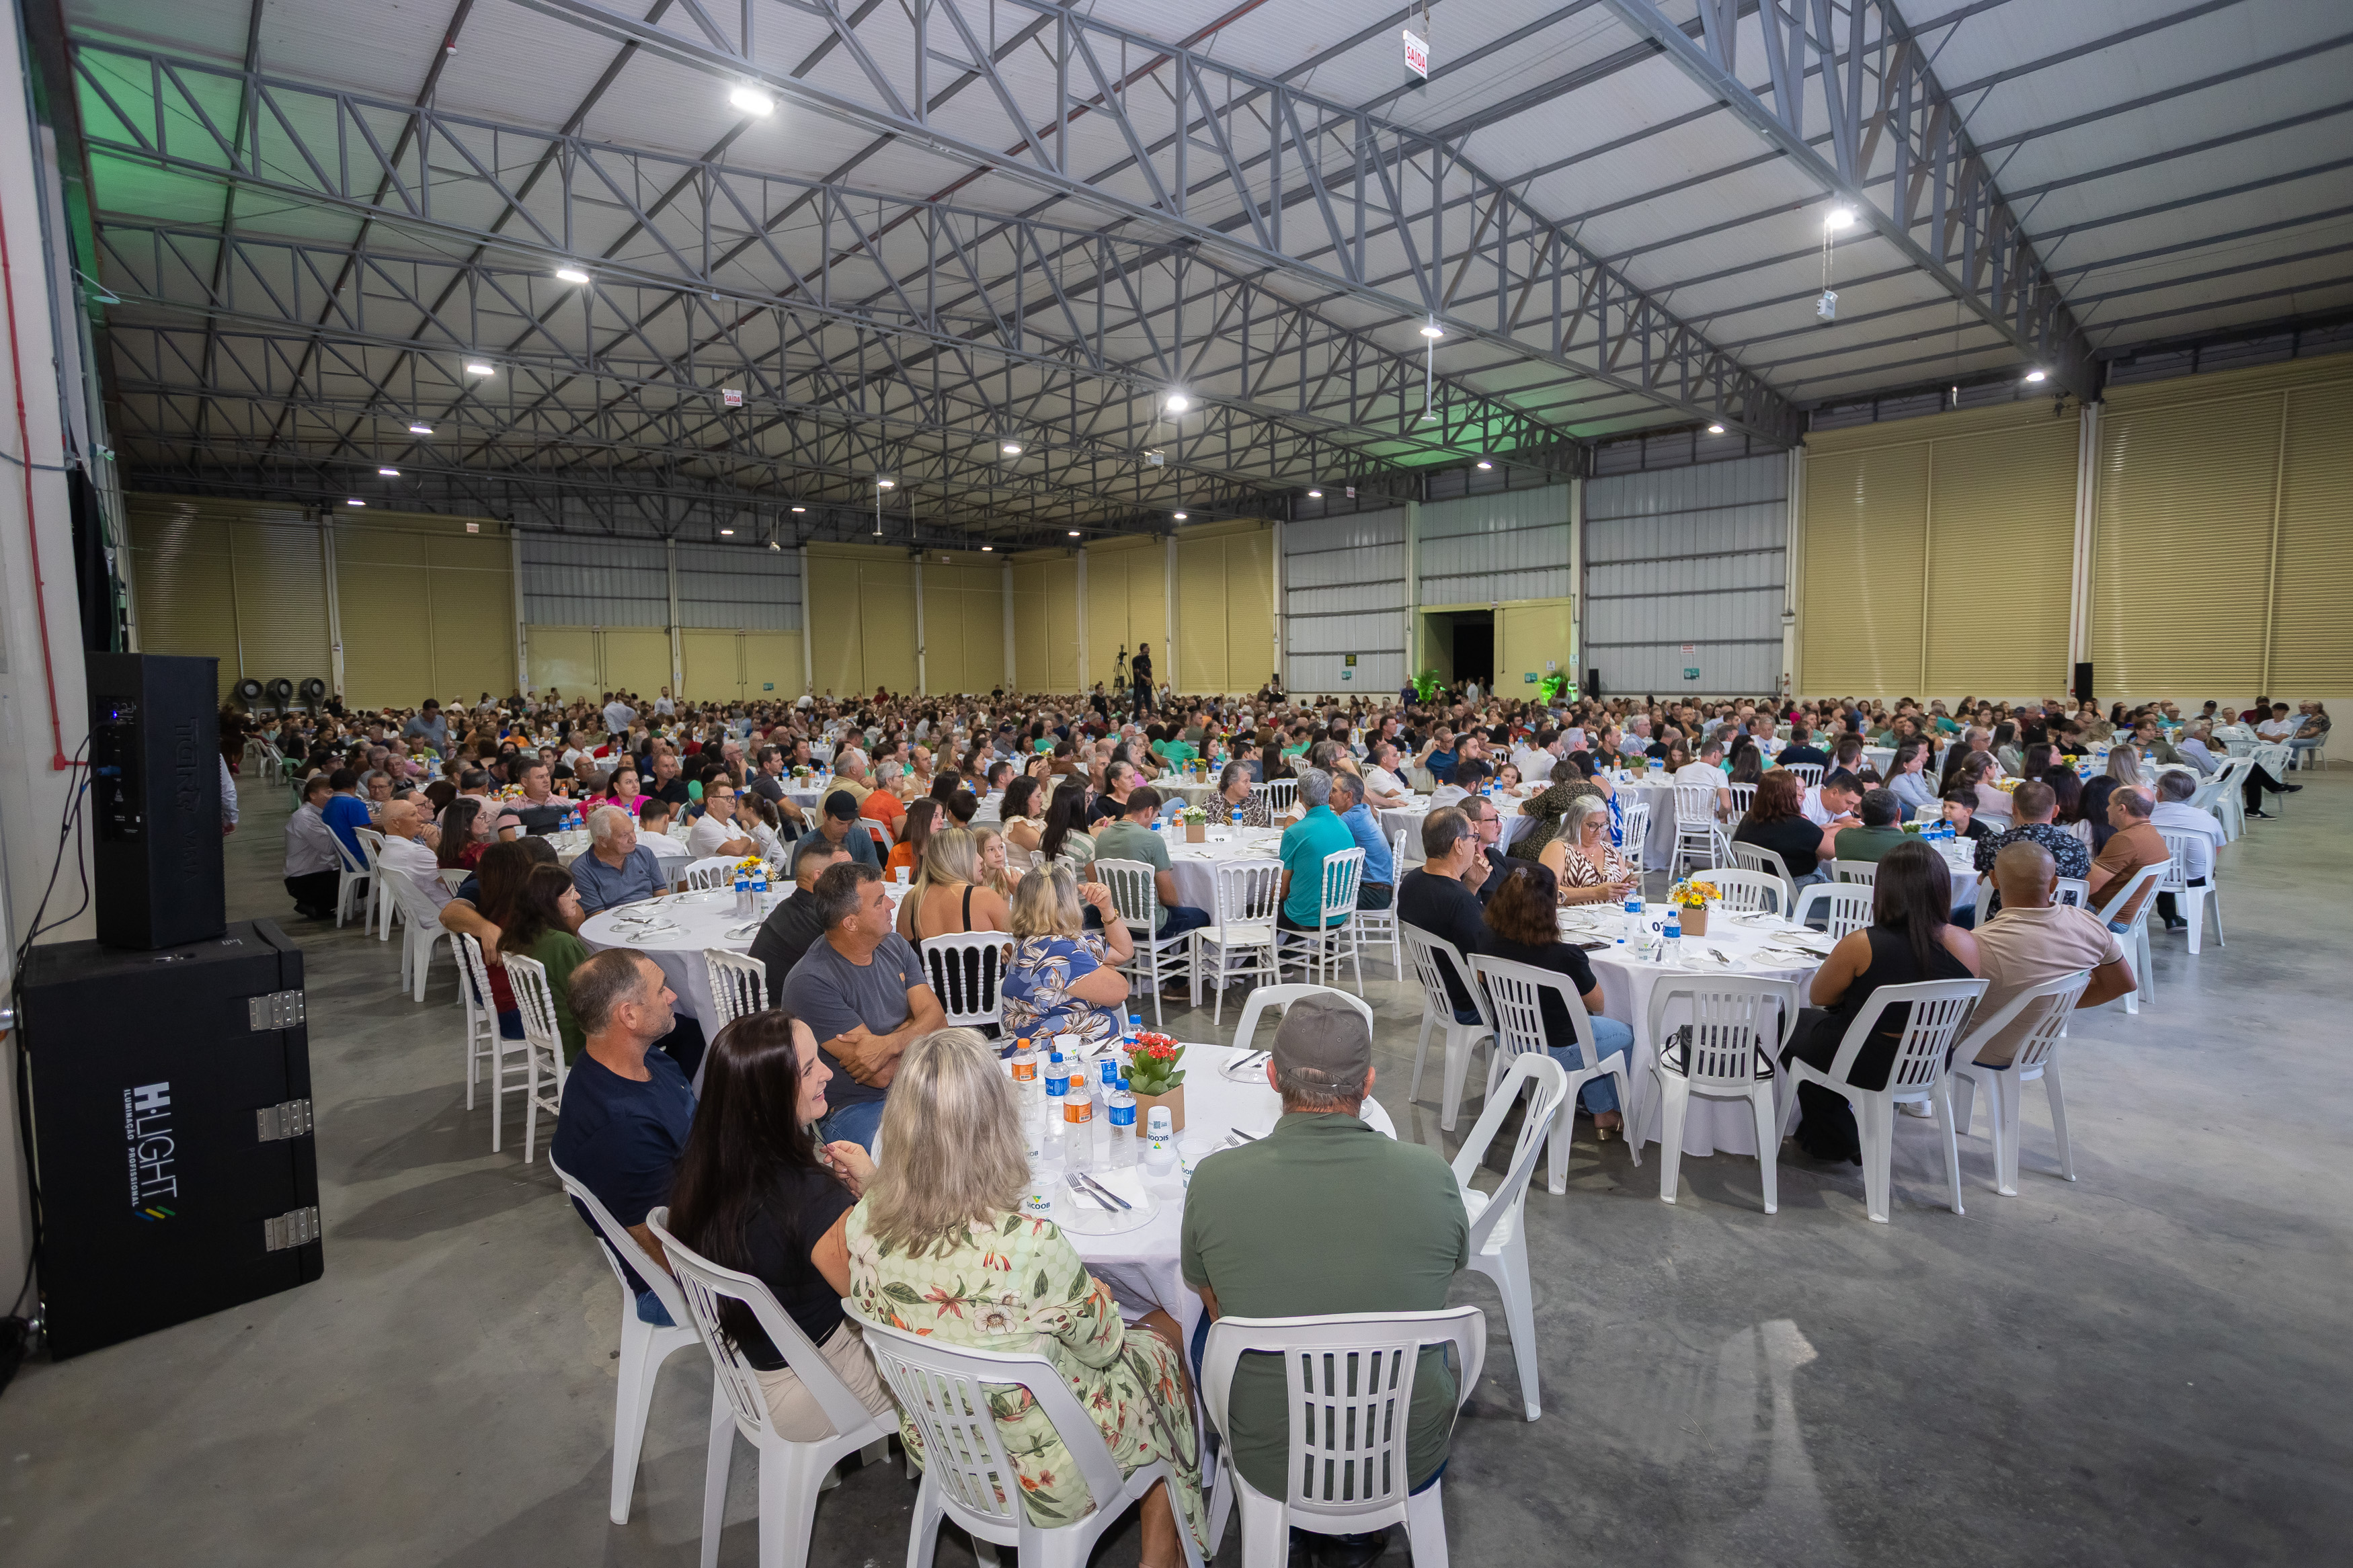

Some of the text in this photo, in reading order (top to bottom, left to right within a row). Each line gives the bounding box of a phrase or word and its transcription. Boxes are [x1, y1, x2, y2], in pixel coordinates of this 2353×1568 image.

[1407, 46, 1426, 70] SAÍDA
[1652, 921, 1664, 932] 0
[124, 1089, 139, 1207] ILUMINAÇÃO PROFISSIONAL
[1027, 1202, 1050, 1210] SICOOB
